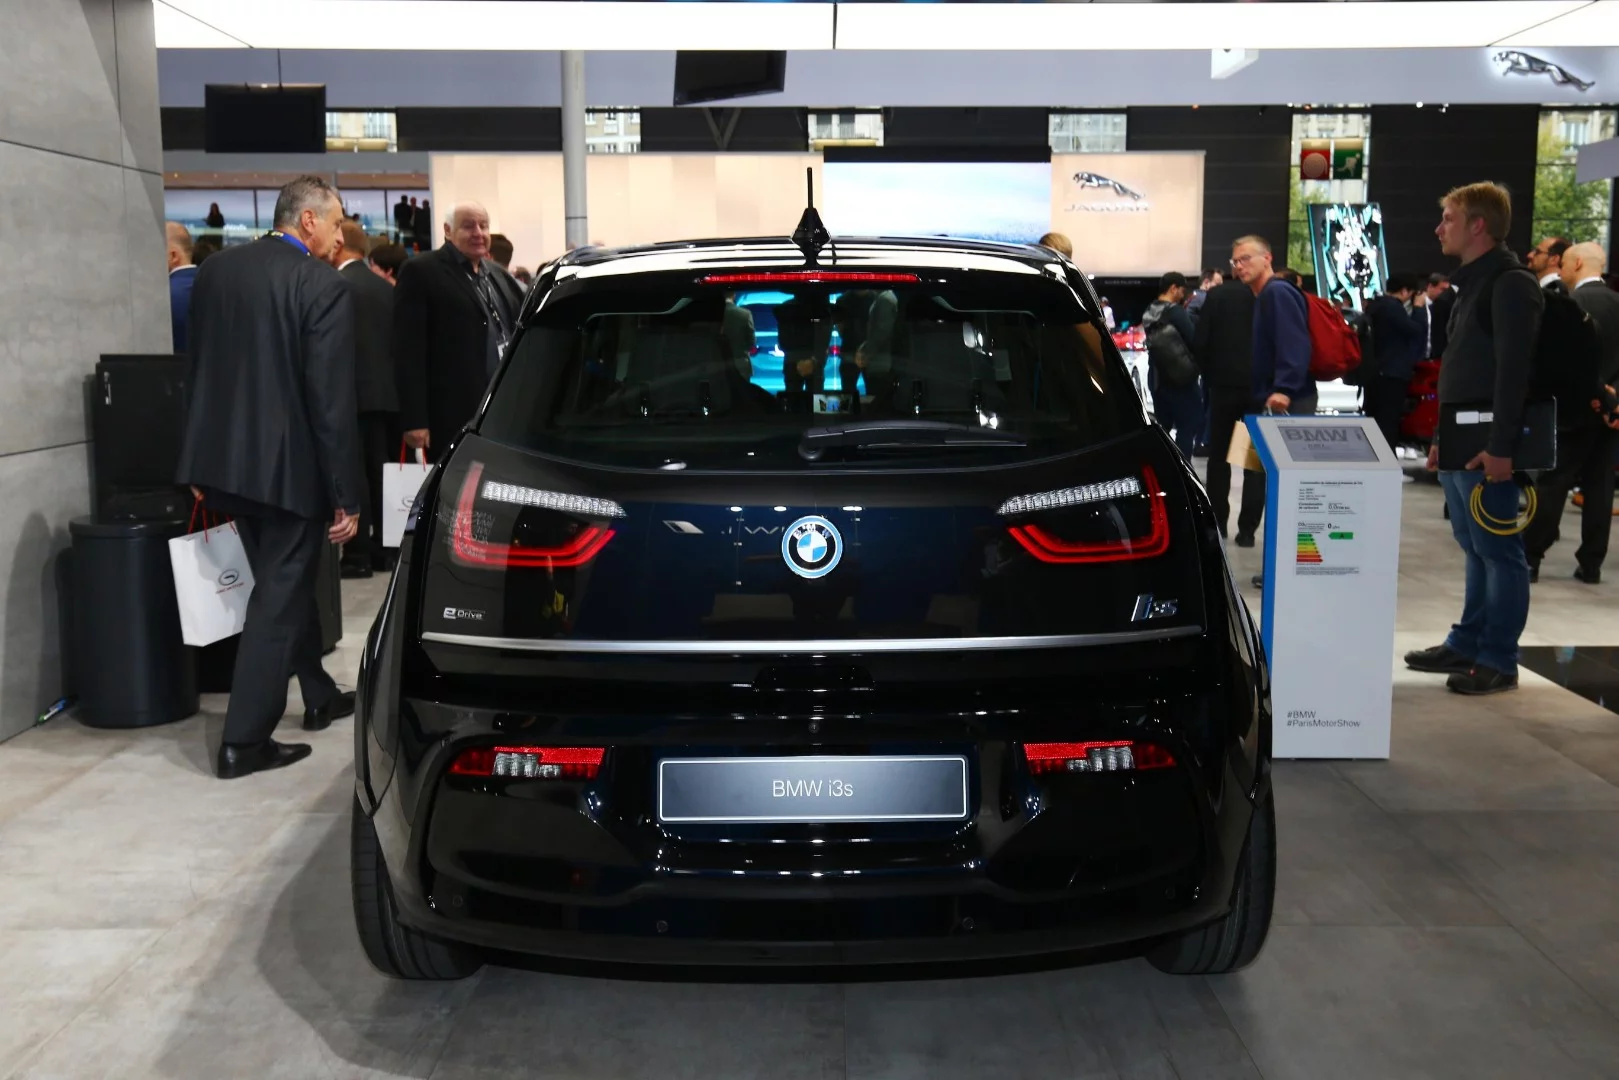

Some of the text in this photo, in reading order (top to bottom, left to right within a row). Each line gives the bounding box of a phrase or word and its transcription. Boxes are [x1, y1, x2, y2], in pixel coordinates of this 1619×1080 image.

[1285, 428, 1348, 442] BMW
[793, 523, 832, 540] BMW
[1287, 710, 1316, 719] #BMW
[1287, 719, 1361, 727] #ParisMotorShow
[772, 779, 854, 797] BMW i3s
